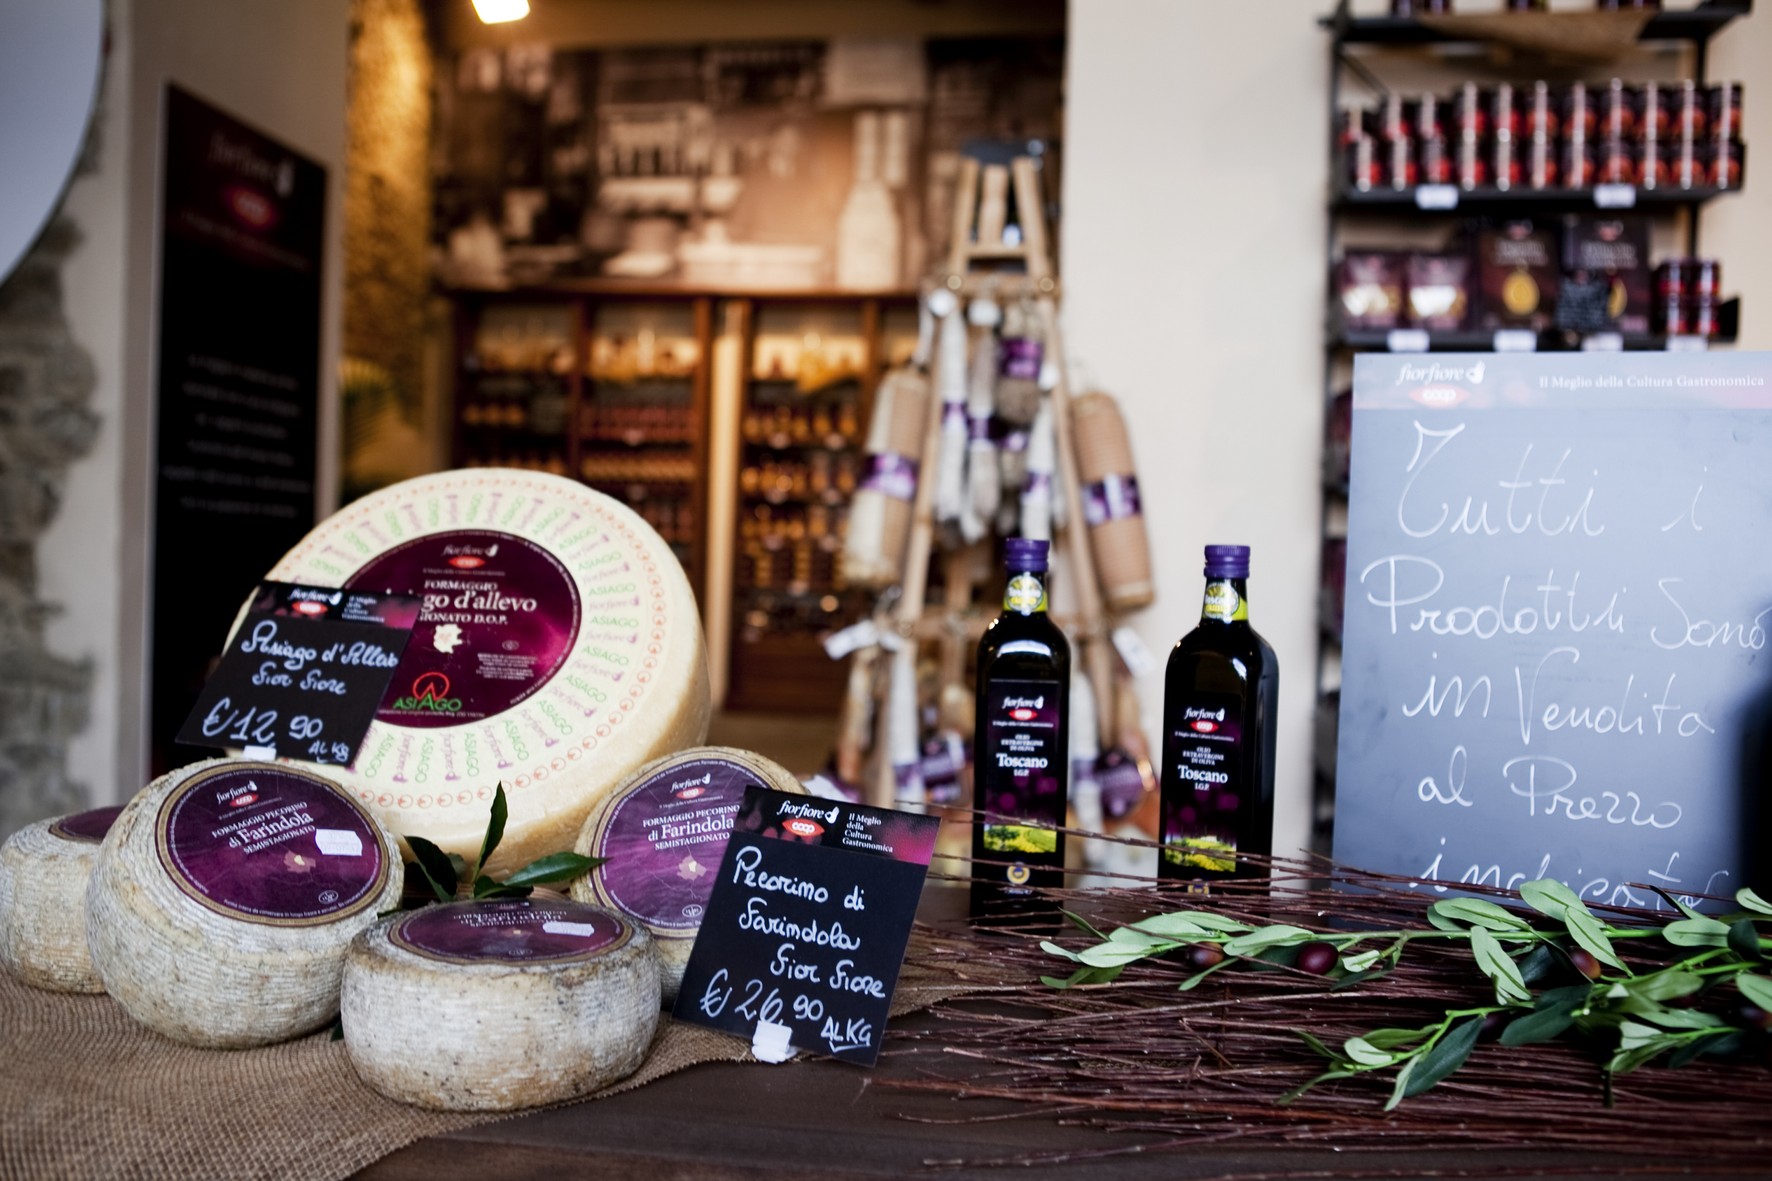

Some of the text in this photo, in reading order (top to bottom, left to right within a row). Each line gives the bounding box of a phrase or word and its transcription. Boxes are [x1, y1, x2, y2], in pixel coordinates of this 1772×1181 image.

[1539, 374, 1765, 391] Il Meglio della Cultura Gastronomica
[1397, 420, 1708, 539] Tutti i
[578, 551, 622, 571] ASIAGO
[424, 580, 498, 591] FORMAGGIO
[588, 583, 636, 597] ASIAGO
[1360, 554, 1627, 639] Prodotti
[454, 590, 538, 612] d'allevo
[590, 615, 639, 628] ASIAGO
[241, 620, 317, 671] Asiago
[582, 645, 629, 666] ASIAGO
[565, 674, 607, 702] ASIAGO
[1401, 647, 1715, 746] in Vendita
[393, 692, 462, 712] ASIAGO
[538, 699, 573, 736] ASIAGO
[1184, 707, 1216, 720] fiorfiore
[504, 719, 530, 761] ASIAGO
[365, 732, 395, 778] ASIAGO
[415, 736, 435, 784] ASIAGO
[464, 732, 480, 777] ASIAGO
[995, 753, 1048, 768] Toscano
[1177, 764, 1228, 784] Toscano
[216, 785, 248, 804] fiorfiore
[670, 778, 702, 793] fiorfiore
[1417, 745, 1682, 829] al Prezzo
[211, 814, 265, 838] FORMAGGIO
[265, 801, 308, 820] PECORINO
[642, 804, 740, 828] FORMAGGIO PECORINO
[776, 800, 825, 819] fiorfiore
[849, 813, 882, 826] Il Meglio
[229, 811, 314, 848] di Farindola
[648, 815, 735, 842] di Farindola
[791, 821, 815, 834] coop
[844, 830, 872, 841] Cultura
[846, 822, 864, 831] della
[243, 825, 315, 855] SEMISTAGIONATO
[655, 831, 731, 851] SEMISTAGIONATO
[842, 837, 893, 853] Gastronomica
[732, 845, 865, 911] Pecorino di
[738, 897, 861, 951] Farindola
[770, 943, 886, 999] Fior Fiore
